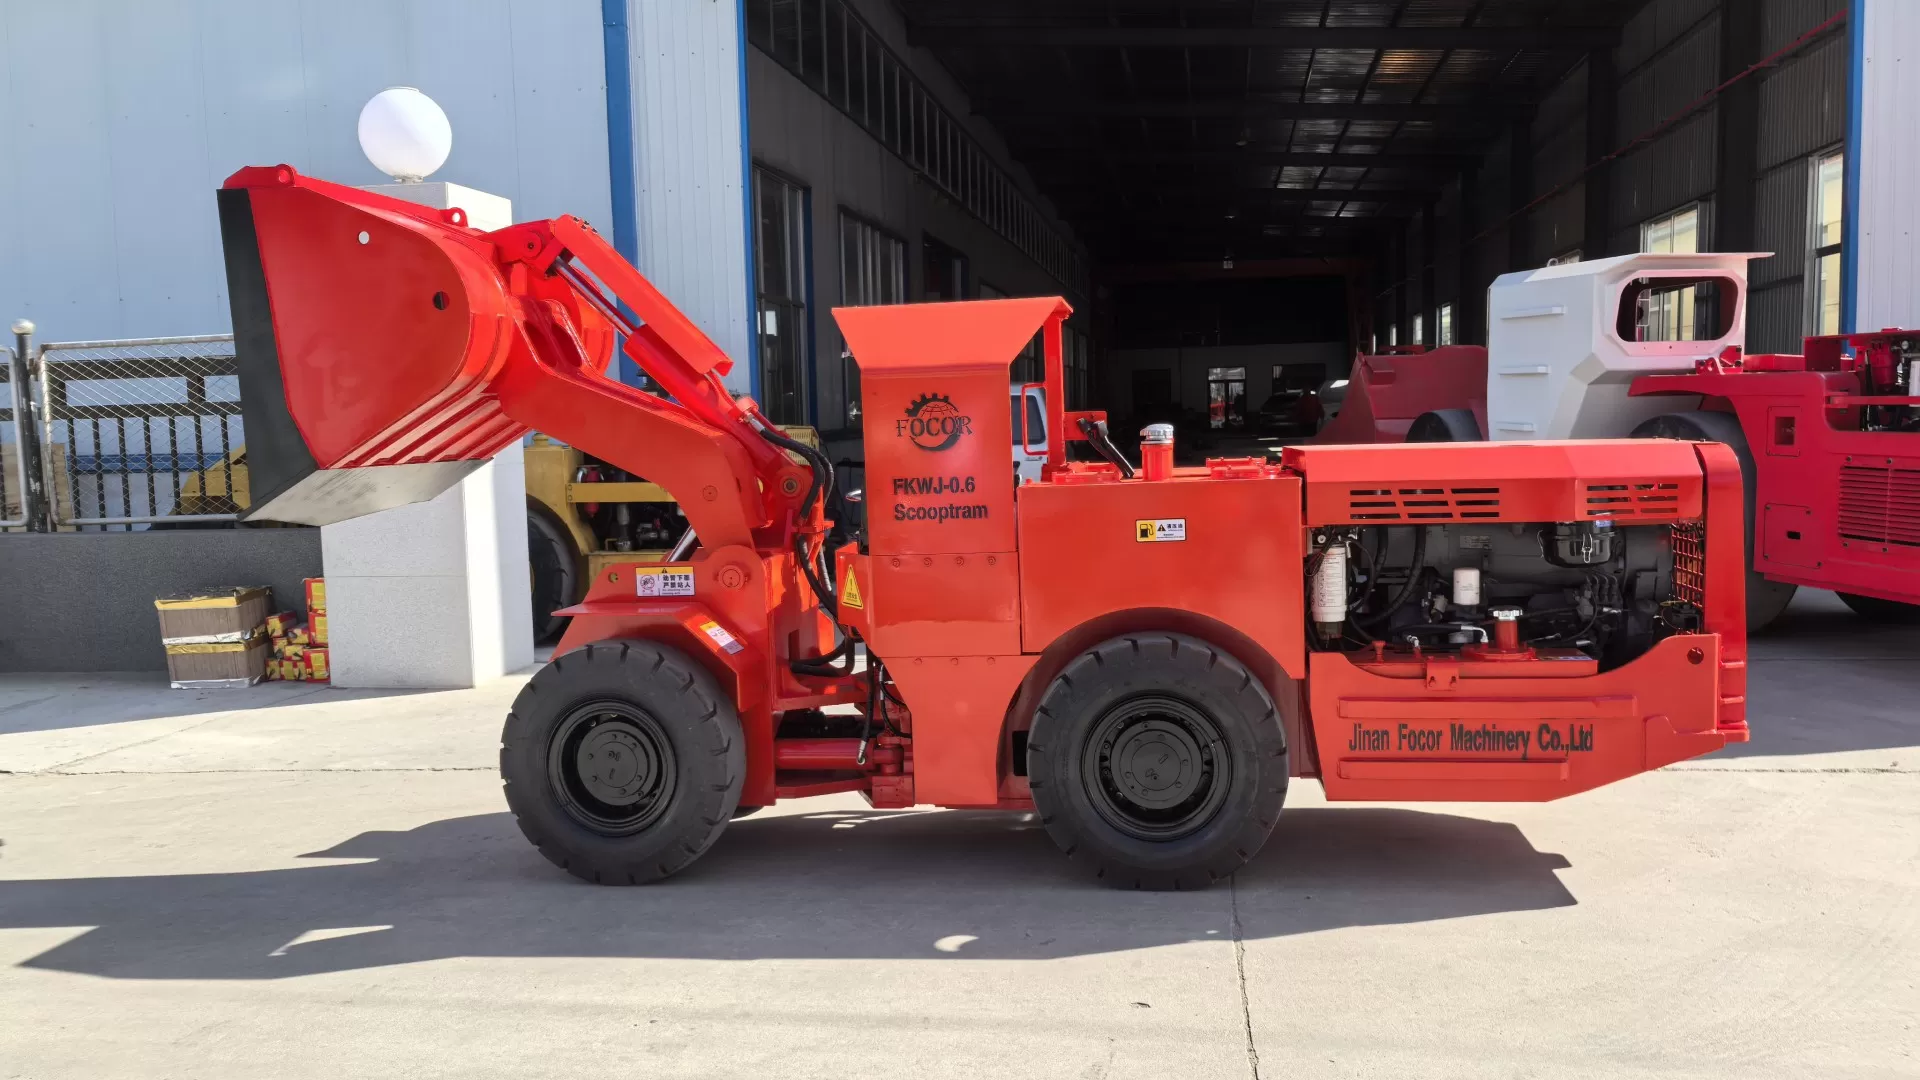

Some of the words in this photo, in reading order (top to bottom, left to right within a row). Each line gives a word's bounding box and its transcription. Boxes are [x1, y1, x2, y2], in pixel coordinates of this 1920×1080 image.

[896, 416, 972, 437] FOCOR
[893, 477, 975, 495] FKWJ-0.6
[894, 504, 988, 523] Scooptram
[1349, 723, 1390, 751] Jinan
[1398, 723, 1443, 751] Focor
[1450, 723, 1530, 760] Machinery
[1537, 723, 1593, 757] Co.,Ltd
